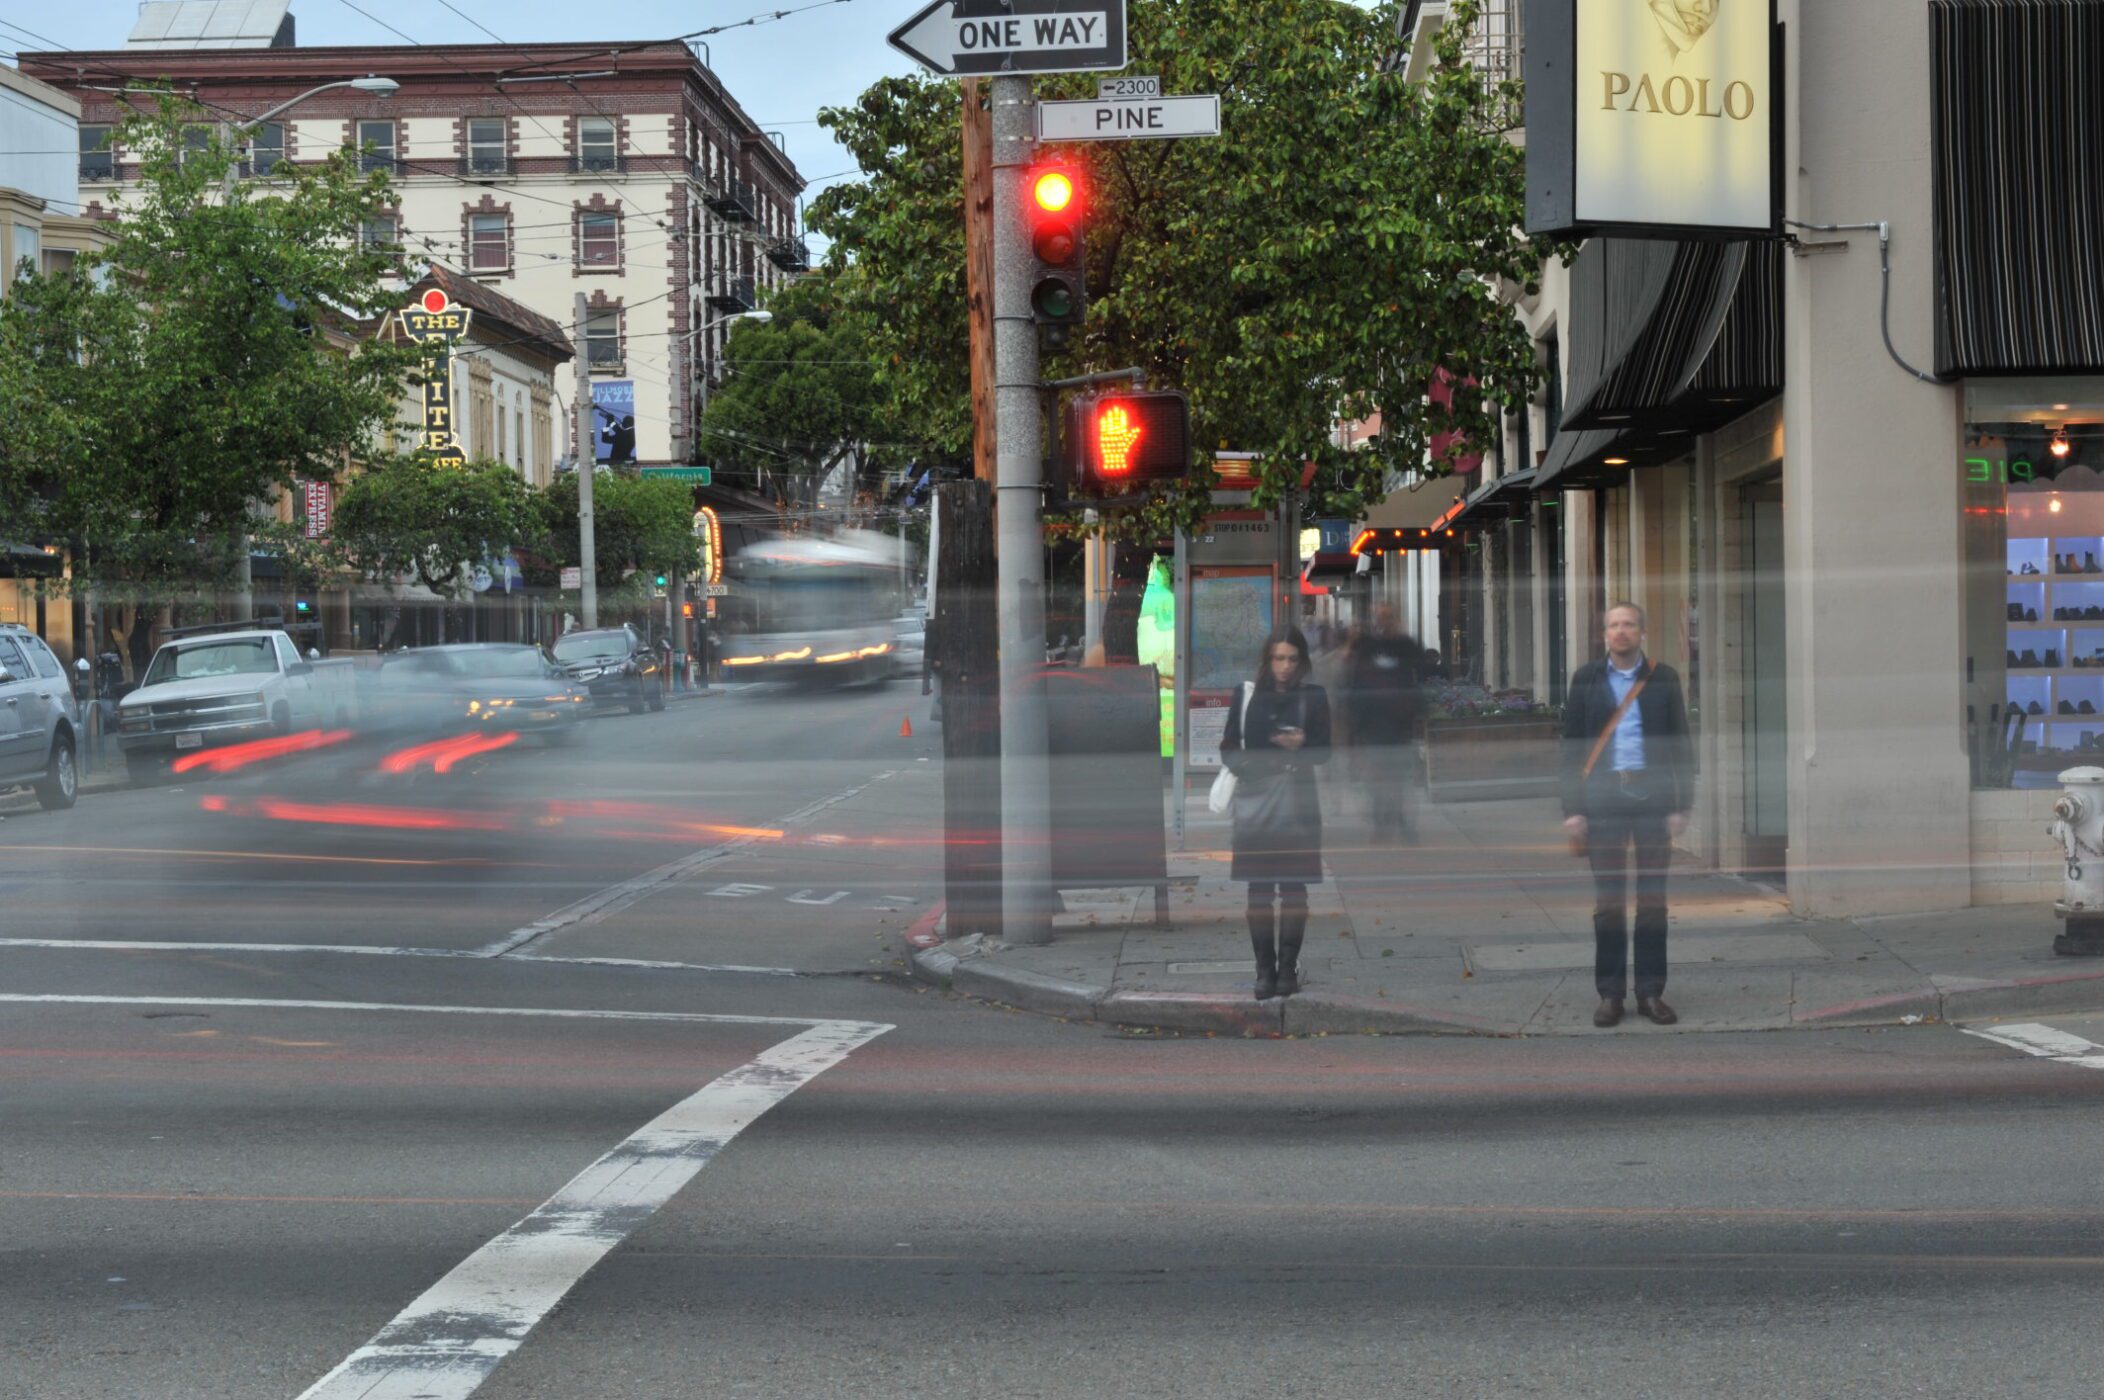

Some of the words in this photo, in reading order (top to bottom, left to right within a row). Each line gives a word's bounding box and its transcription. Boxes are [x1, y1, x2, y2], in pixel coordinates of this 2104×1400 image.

[959, 20, 1021, 49] ONE
[1034, 16, 1097, 46] WAY
[1116, 79, 1156, 94] 2300
[1600, 71, 1754, 120] PAOLO
[1096, 107, 1163, 130] PINE
[412, 315, 460, 329] THE
[592, 391, 634, 403] JAZZ
[308, 483, 317, 536] EXPRESS
[318, 484, 327, 533] VITAMIN
[1205, 535, 1215, 543] 22
[1206, 697, 1222, 707] info
